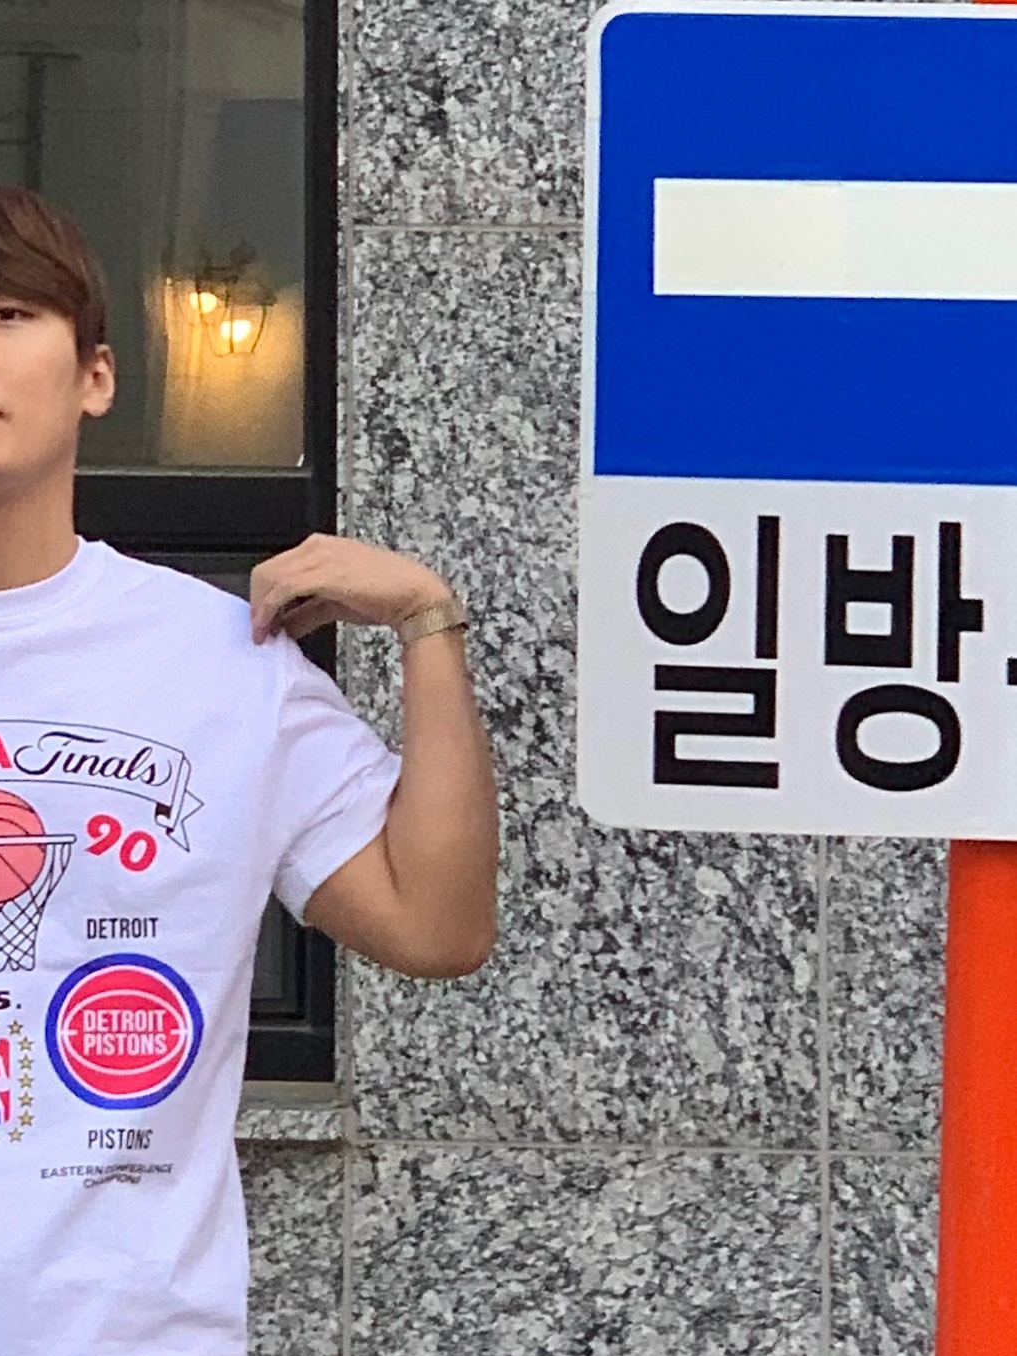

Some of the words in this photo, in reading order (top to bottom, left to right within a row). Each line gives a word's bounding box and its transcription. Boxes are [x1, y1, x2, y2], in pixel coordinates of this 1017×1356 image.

[636, 515, 1017, 793] 일방
[13, 731, 172, 787] Finals
[85, 814, 158, 873] 90
[87, 918, 158, 939] DETROIT
[83, 1009, 166, 1033] DETROIT
[83, 1033, 168, 1056] PISTONS
[88, 1128, 153, 1150] PISTONS
[41, 1165, 103, 1179] EASTERN
